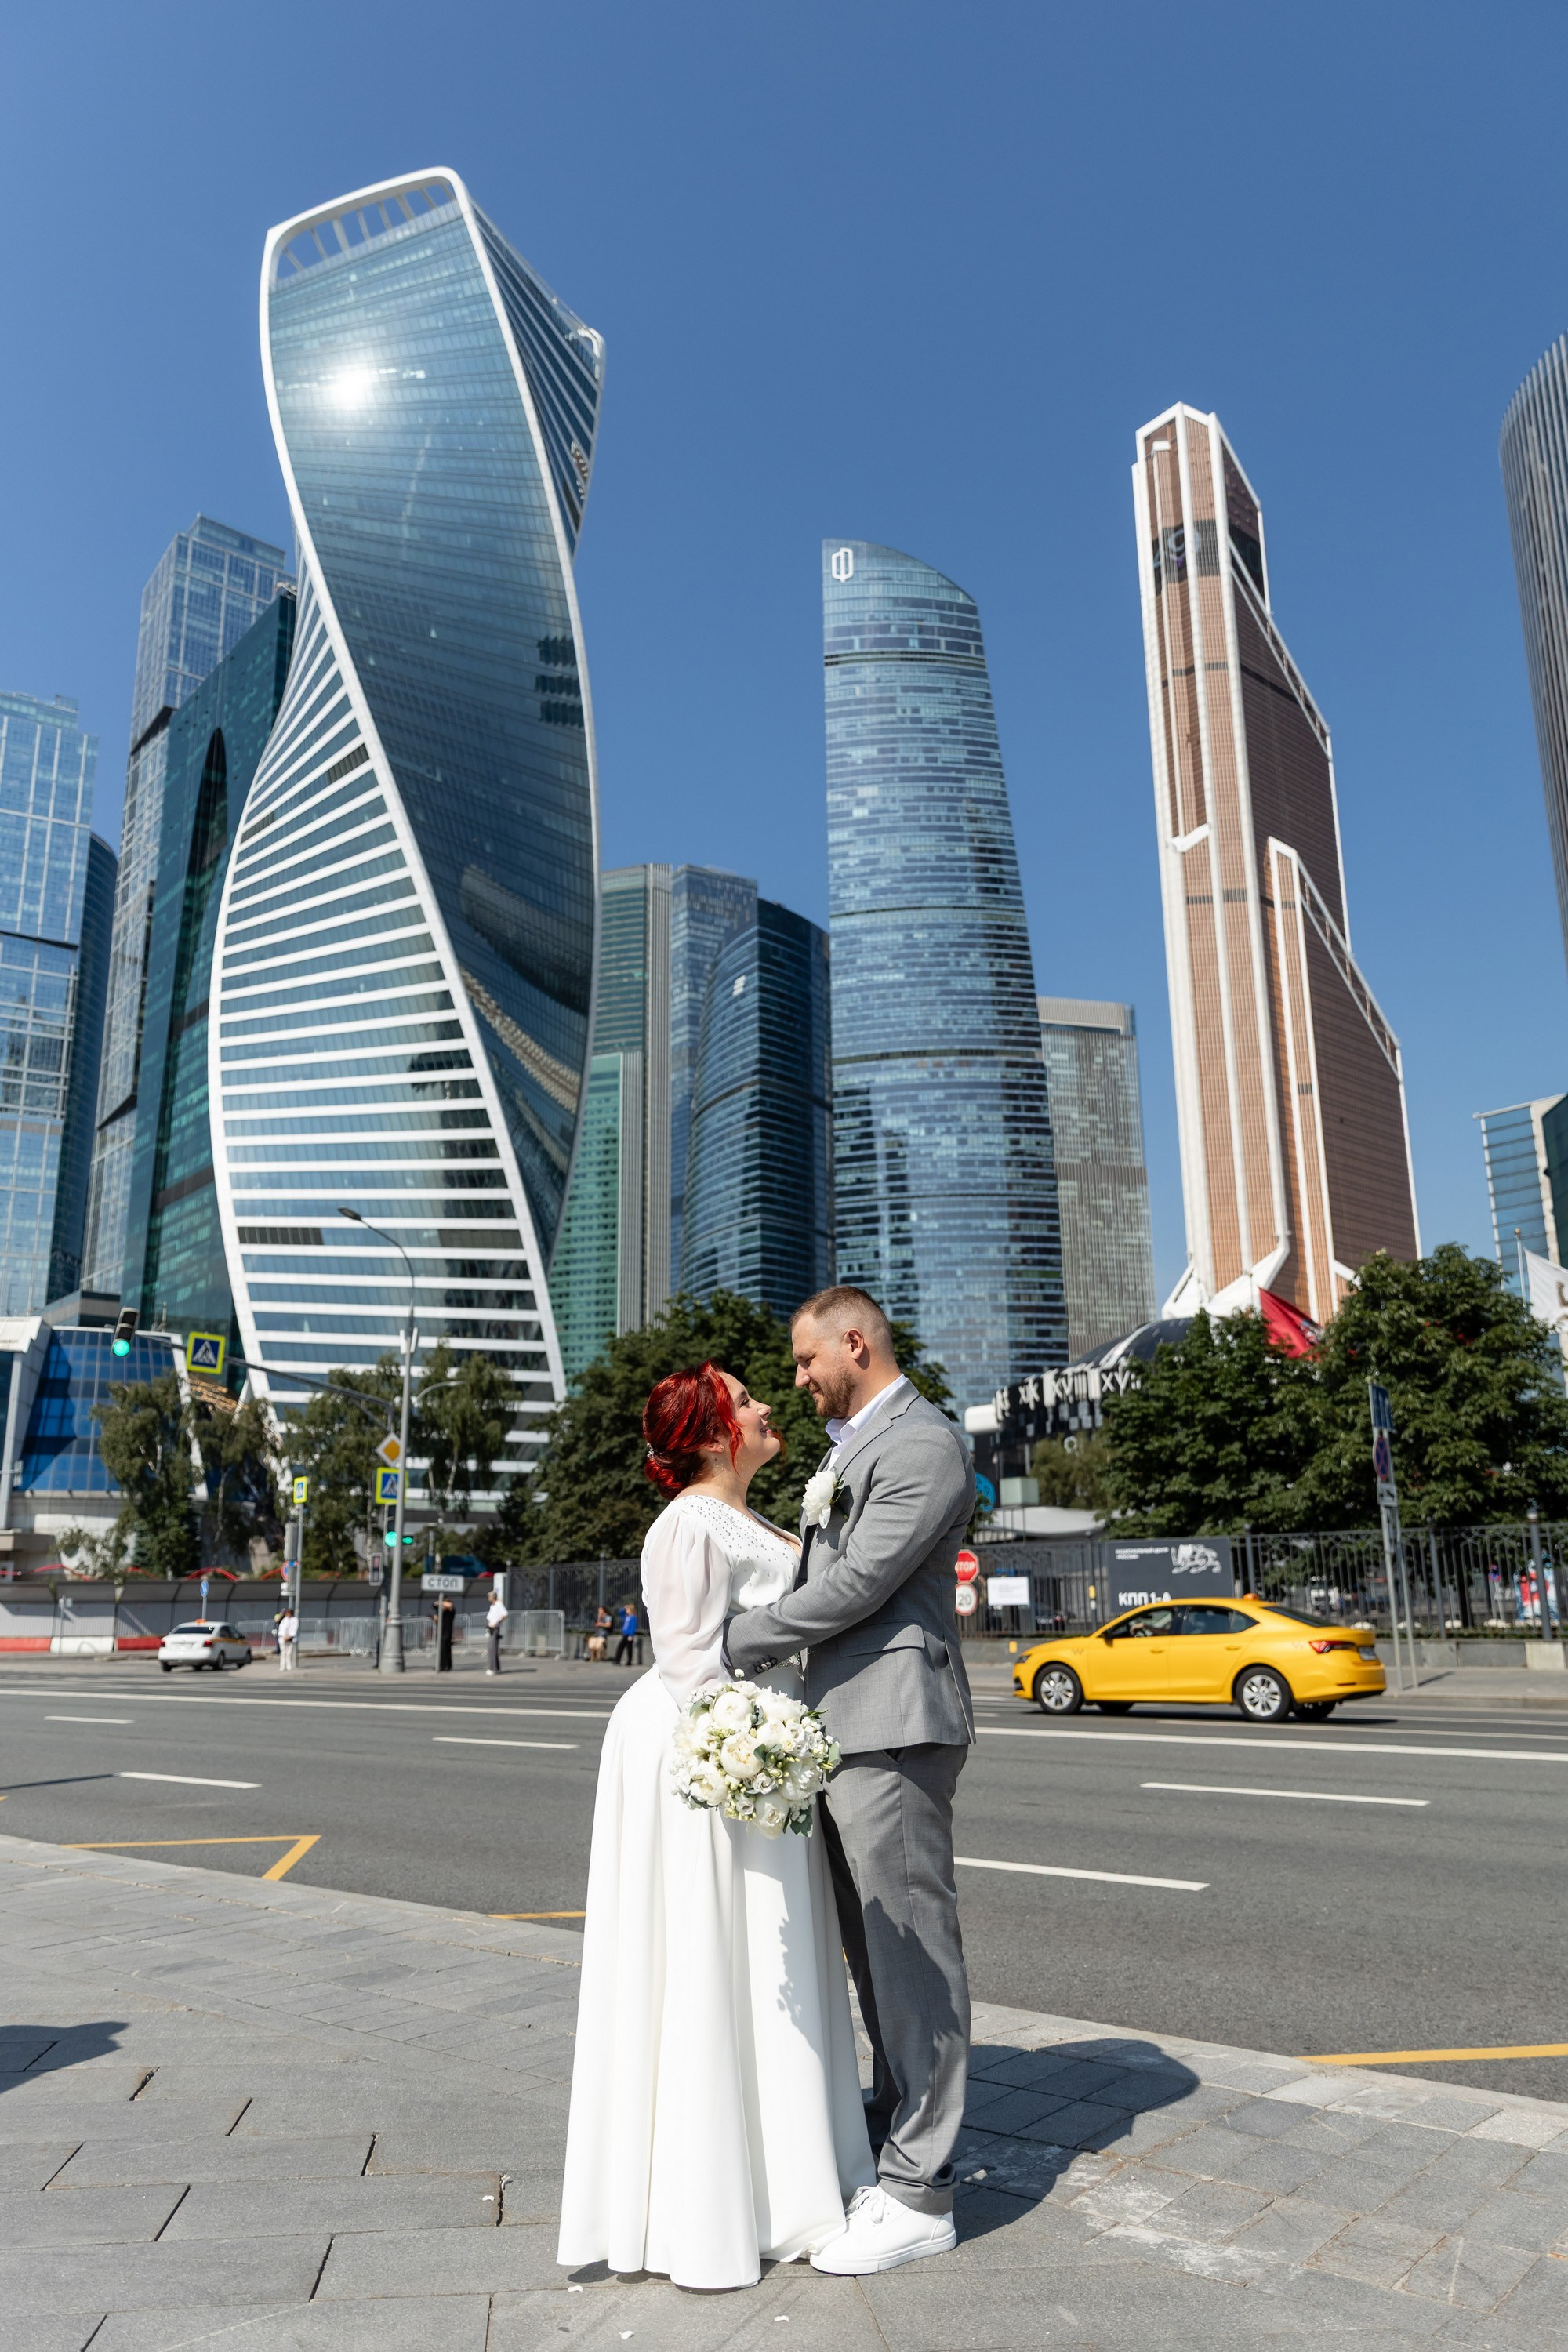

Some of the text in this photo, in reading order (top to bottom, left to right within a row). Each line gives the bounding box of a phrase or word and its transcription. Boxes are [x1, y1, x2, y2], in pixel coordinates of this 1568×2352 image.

[427, 1577, 458, 1588] СТОП
[957, 1593, 971, 1606] 20
[1119, 1592, 1149, 1606] КПП
